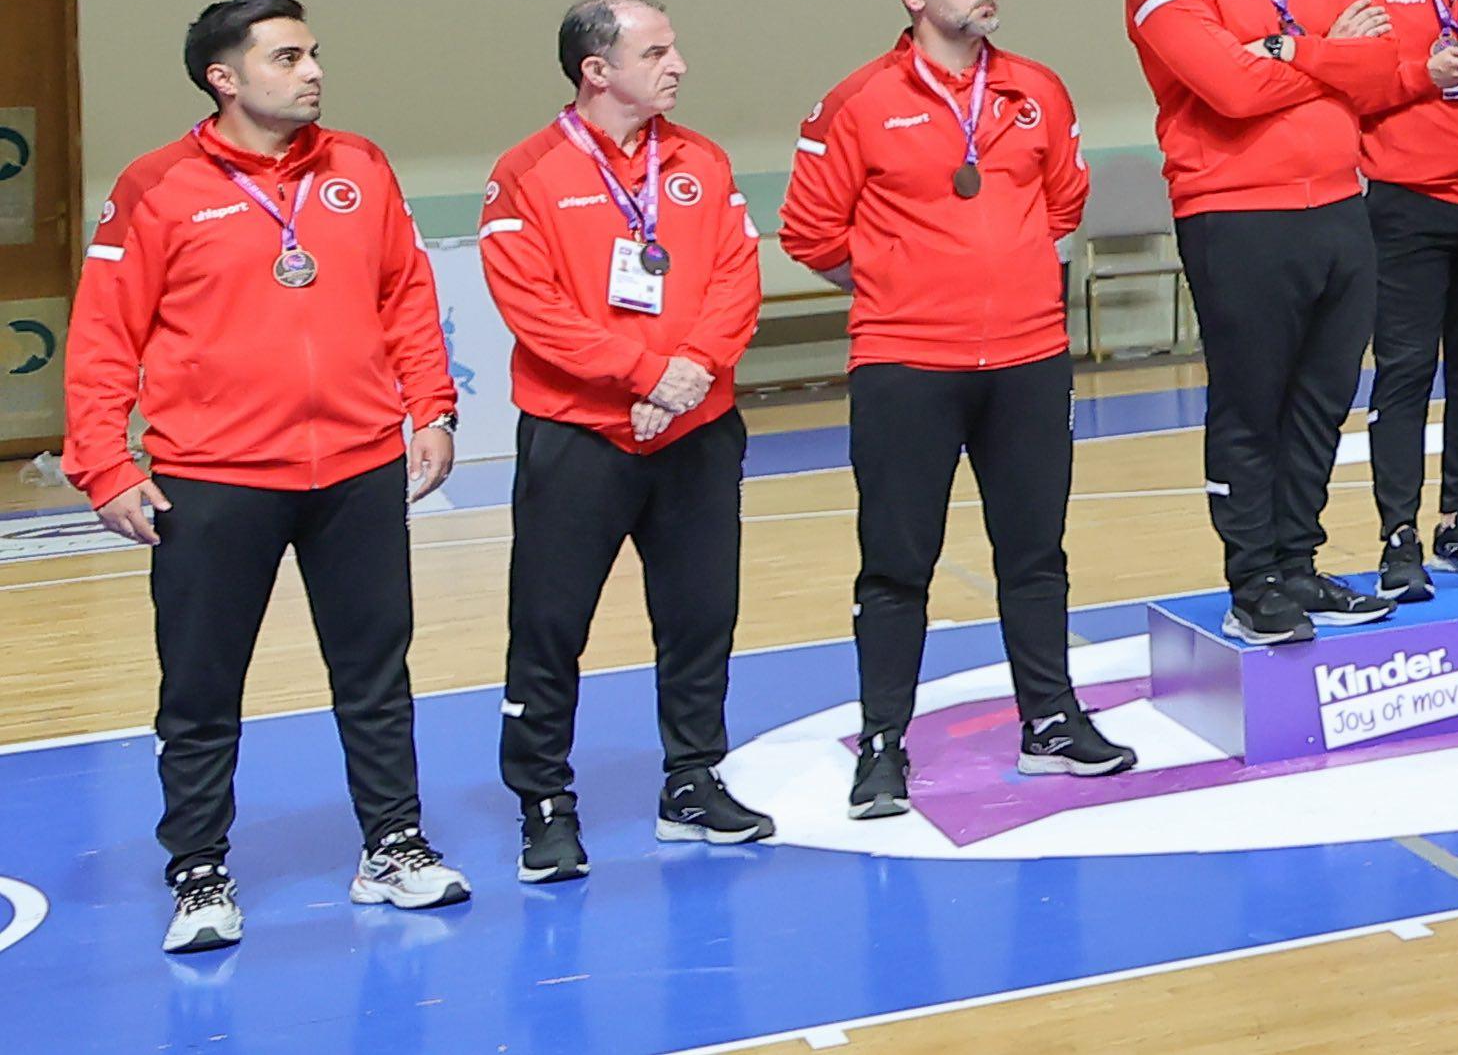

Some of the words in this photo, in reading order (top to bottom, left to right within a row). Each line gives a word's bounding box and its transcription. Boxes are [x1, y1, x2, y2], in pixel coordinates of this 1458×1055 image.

[192, 201, 250, 224] uhlsport
[557, 193, 608, 210] uhlsport
[1332, 706, 1376, 735] Joy
[1381, 692, 1406, 723] of
